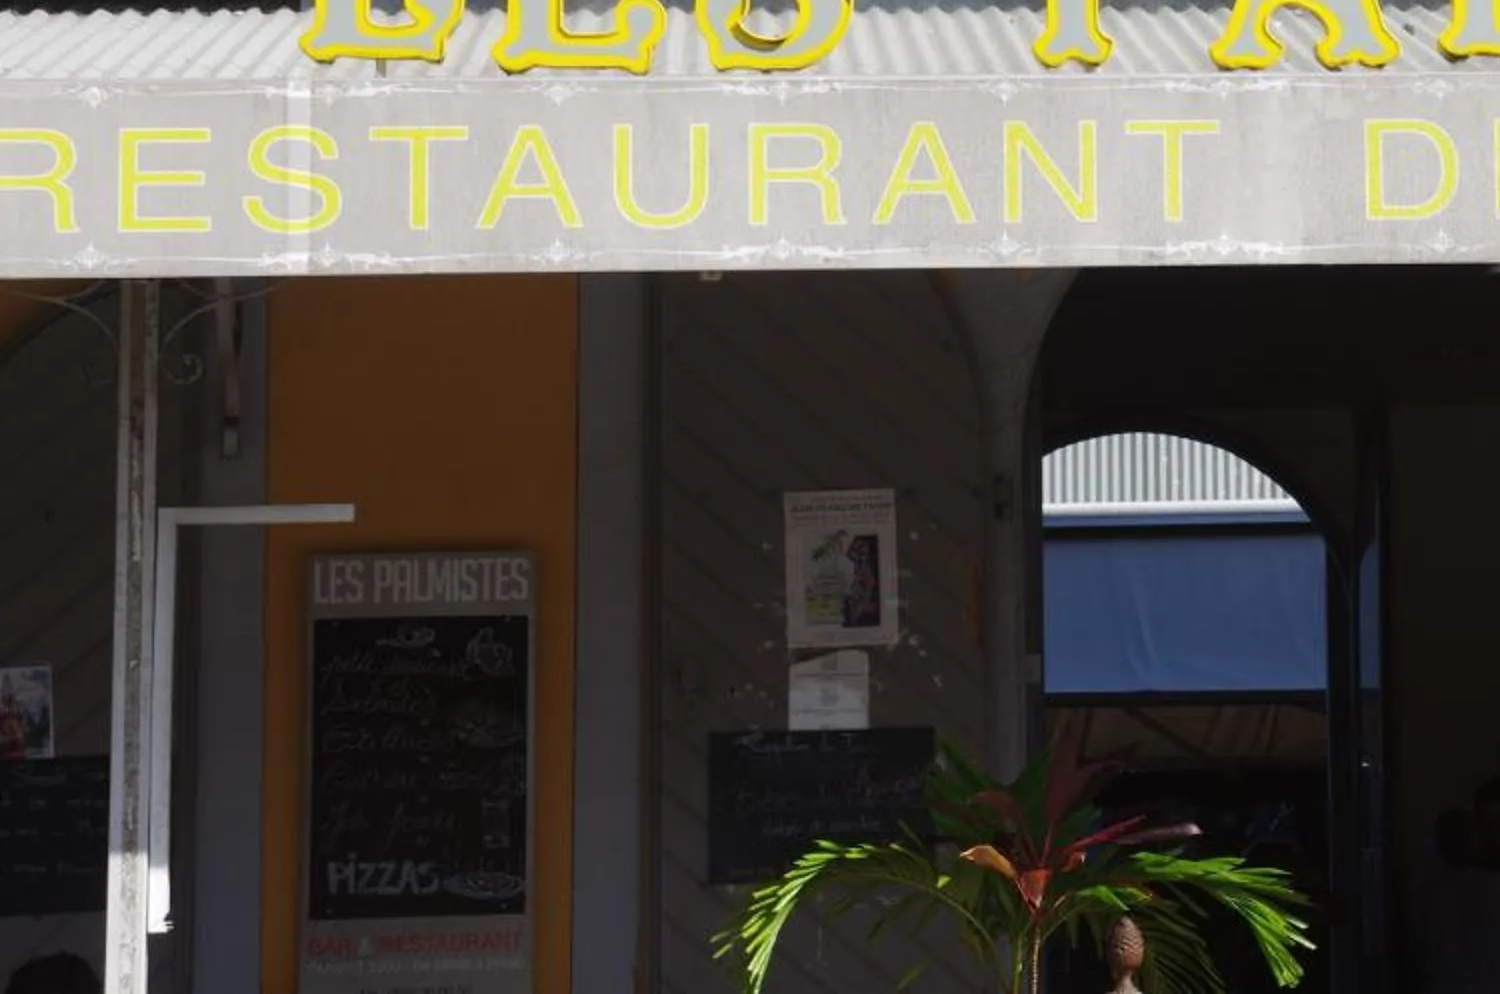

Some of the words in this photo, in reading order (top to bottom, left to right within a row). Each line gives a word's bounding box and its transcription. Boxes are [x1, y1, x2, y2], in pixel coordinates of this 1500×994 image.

[0, 118, 1220, 233] RESTAURANT
[314, 558, 364, 604] LES
[373, 557, 529, 603] PALMISTES
